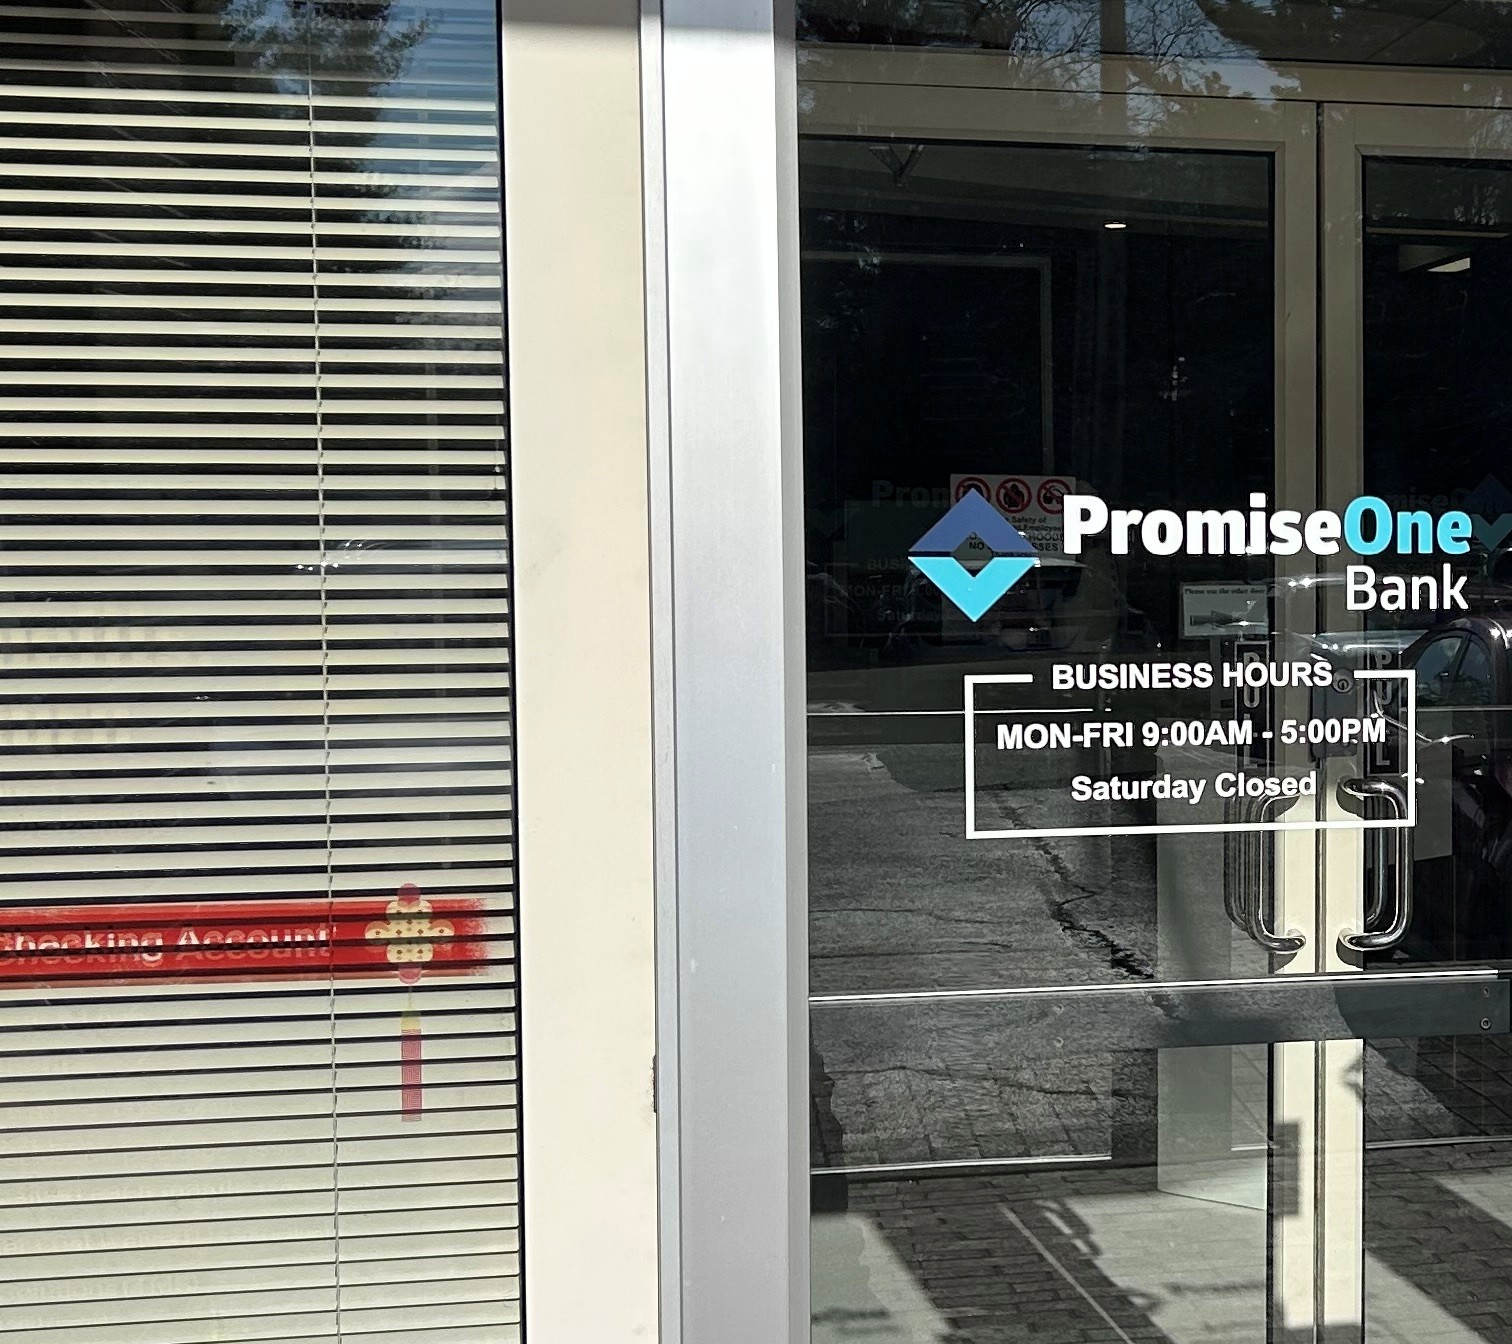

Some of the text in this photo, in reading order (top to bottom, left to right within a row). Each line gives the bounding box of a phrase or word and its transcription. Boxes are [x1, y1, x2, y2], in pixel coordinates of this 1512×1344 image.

[1064, 493, 1472, 555] PromiseOne
[969, 542, 985, 550] NO
[1347, 563, 1468, 610] Bank
[1053, 661, 1332, 689] BUSINESS HOURS
[998, 722, 1133, 749] MON-FRI
[1142, 720, 1252, 746] 9:00AM
[1281, 717, 1385, 744] 5:00PM
[1072, 771, 1316, 804] Saturday Closed
